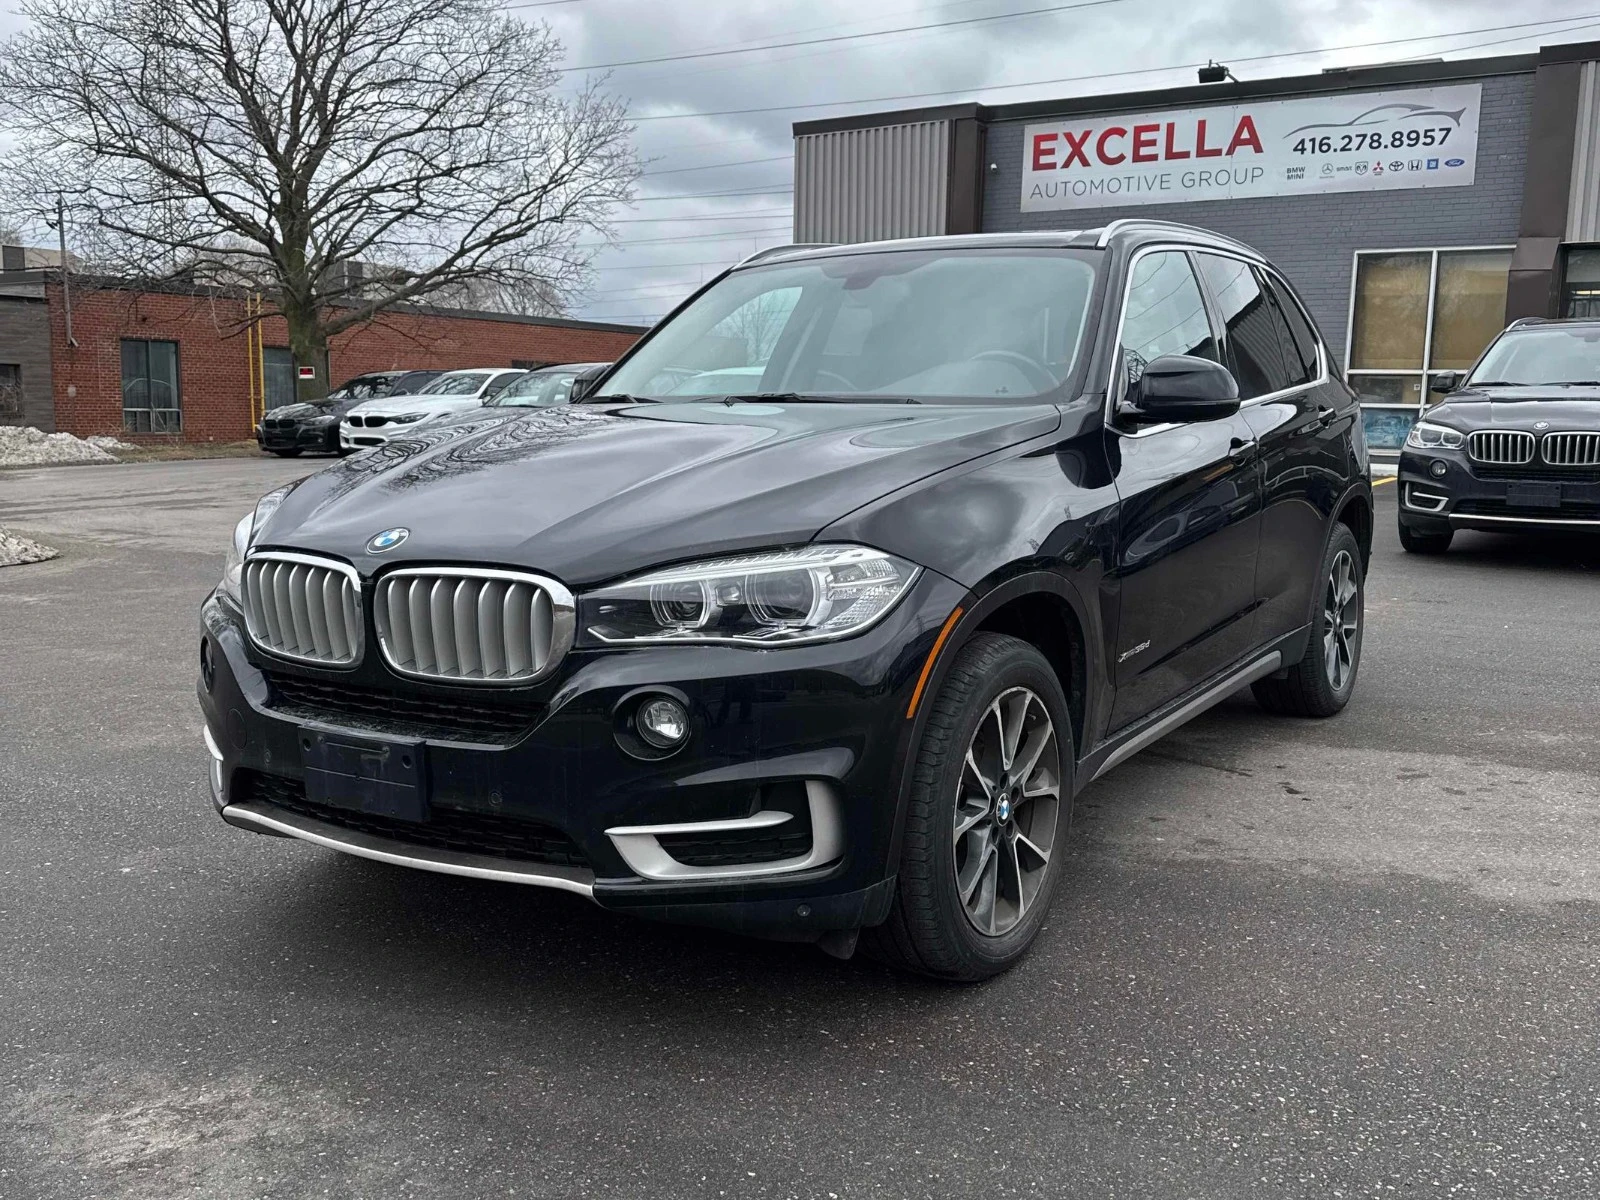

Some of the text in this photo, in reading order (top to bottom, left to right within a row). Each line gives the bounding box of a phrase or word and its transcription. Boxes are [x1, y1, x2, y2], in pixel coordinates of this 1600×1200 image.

[1032, 115, 1264, 171] EXCELLA
[1293, 127, 1452, 155] 416.278.8957
[1030, 167, 1264, 199] AUTOMOTIVE GROUP
[1286, 166, 1306, 174] BMW
